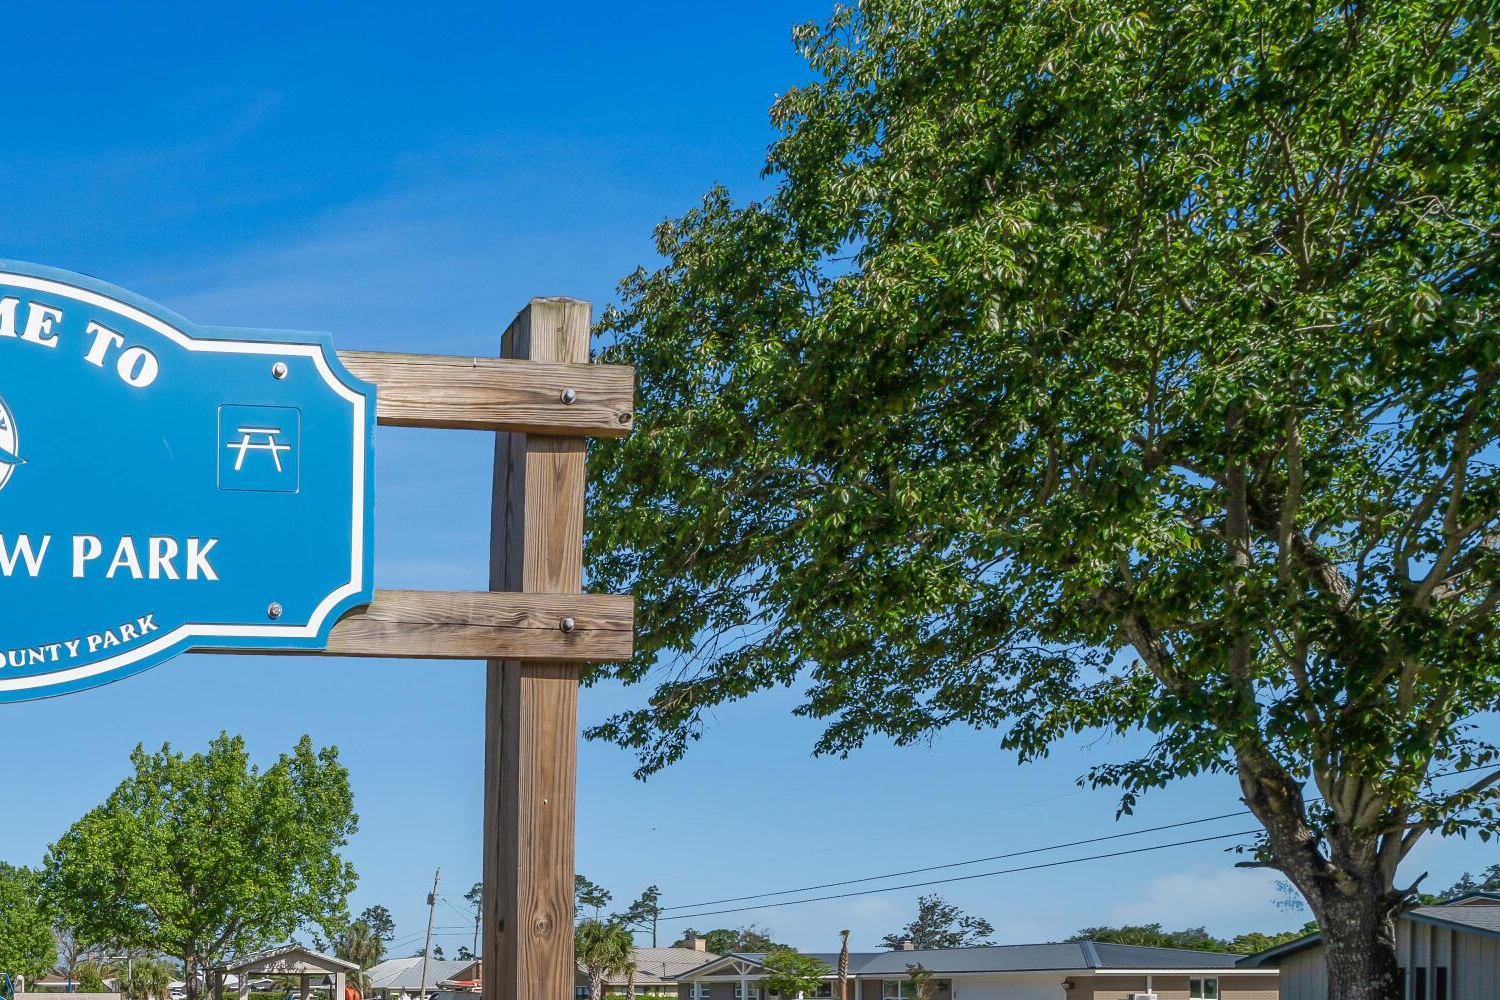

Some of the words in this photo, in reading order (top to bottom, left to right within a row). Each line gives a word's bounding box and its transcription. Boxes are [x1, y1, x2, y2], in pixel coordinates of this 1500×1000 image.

[83, 321, 160, 388] TO
[72, 535, 220, 581] PARK
[86, 613, 159, 653] PARK
